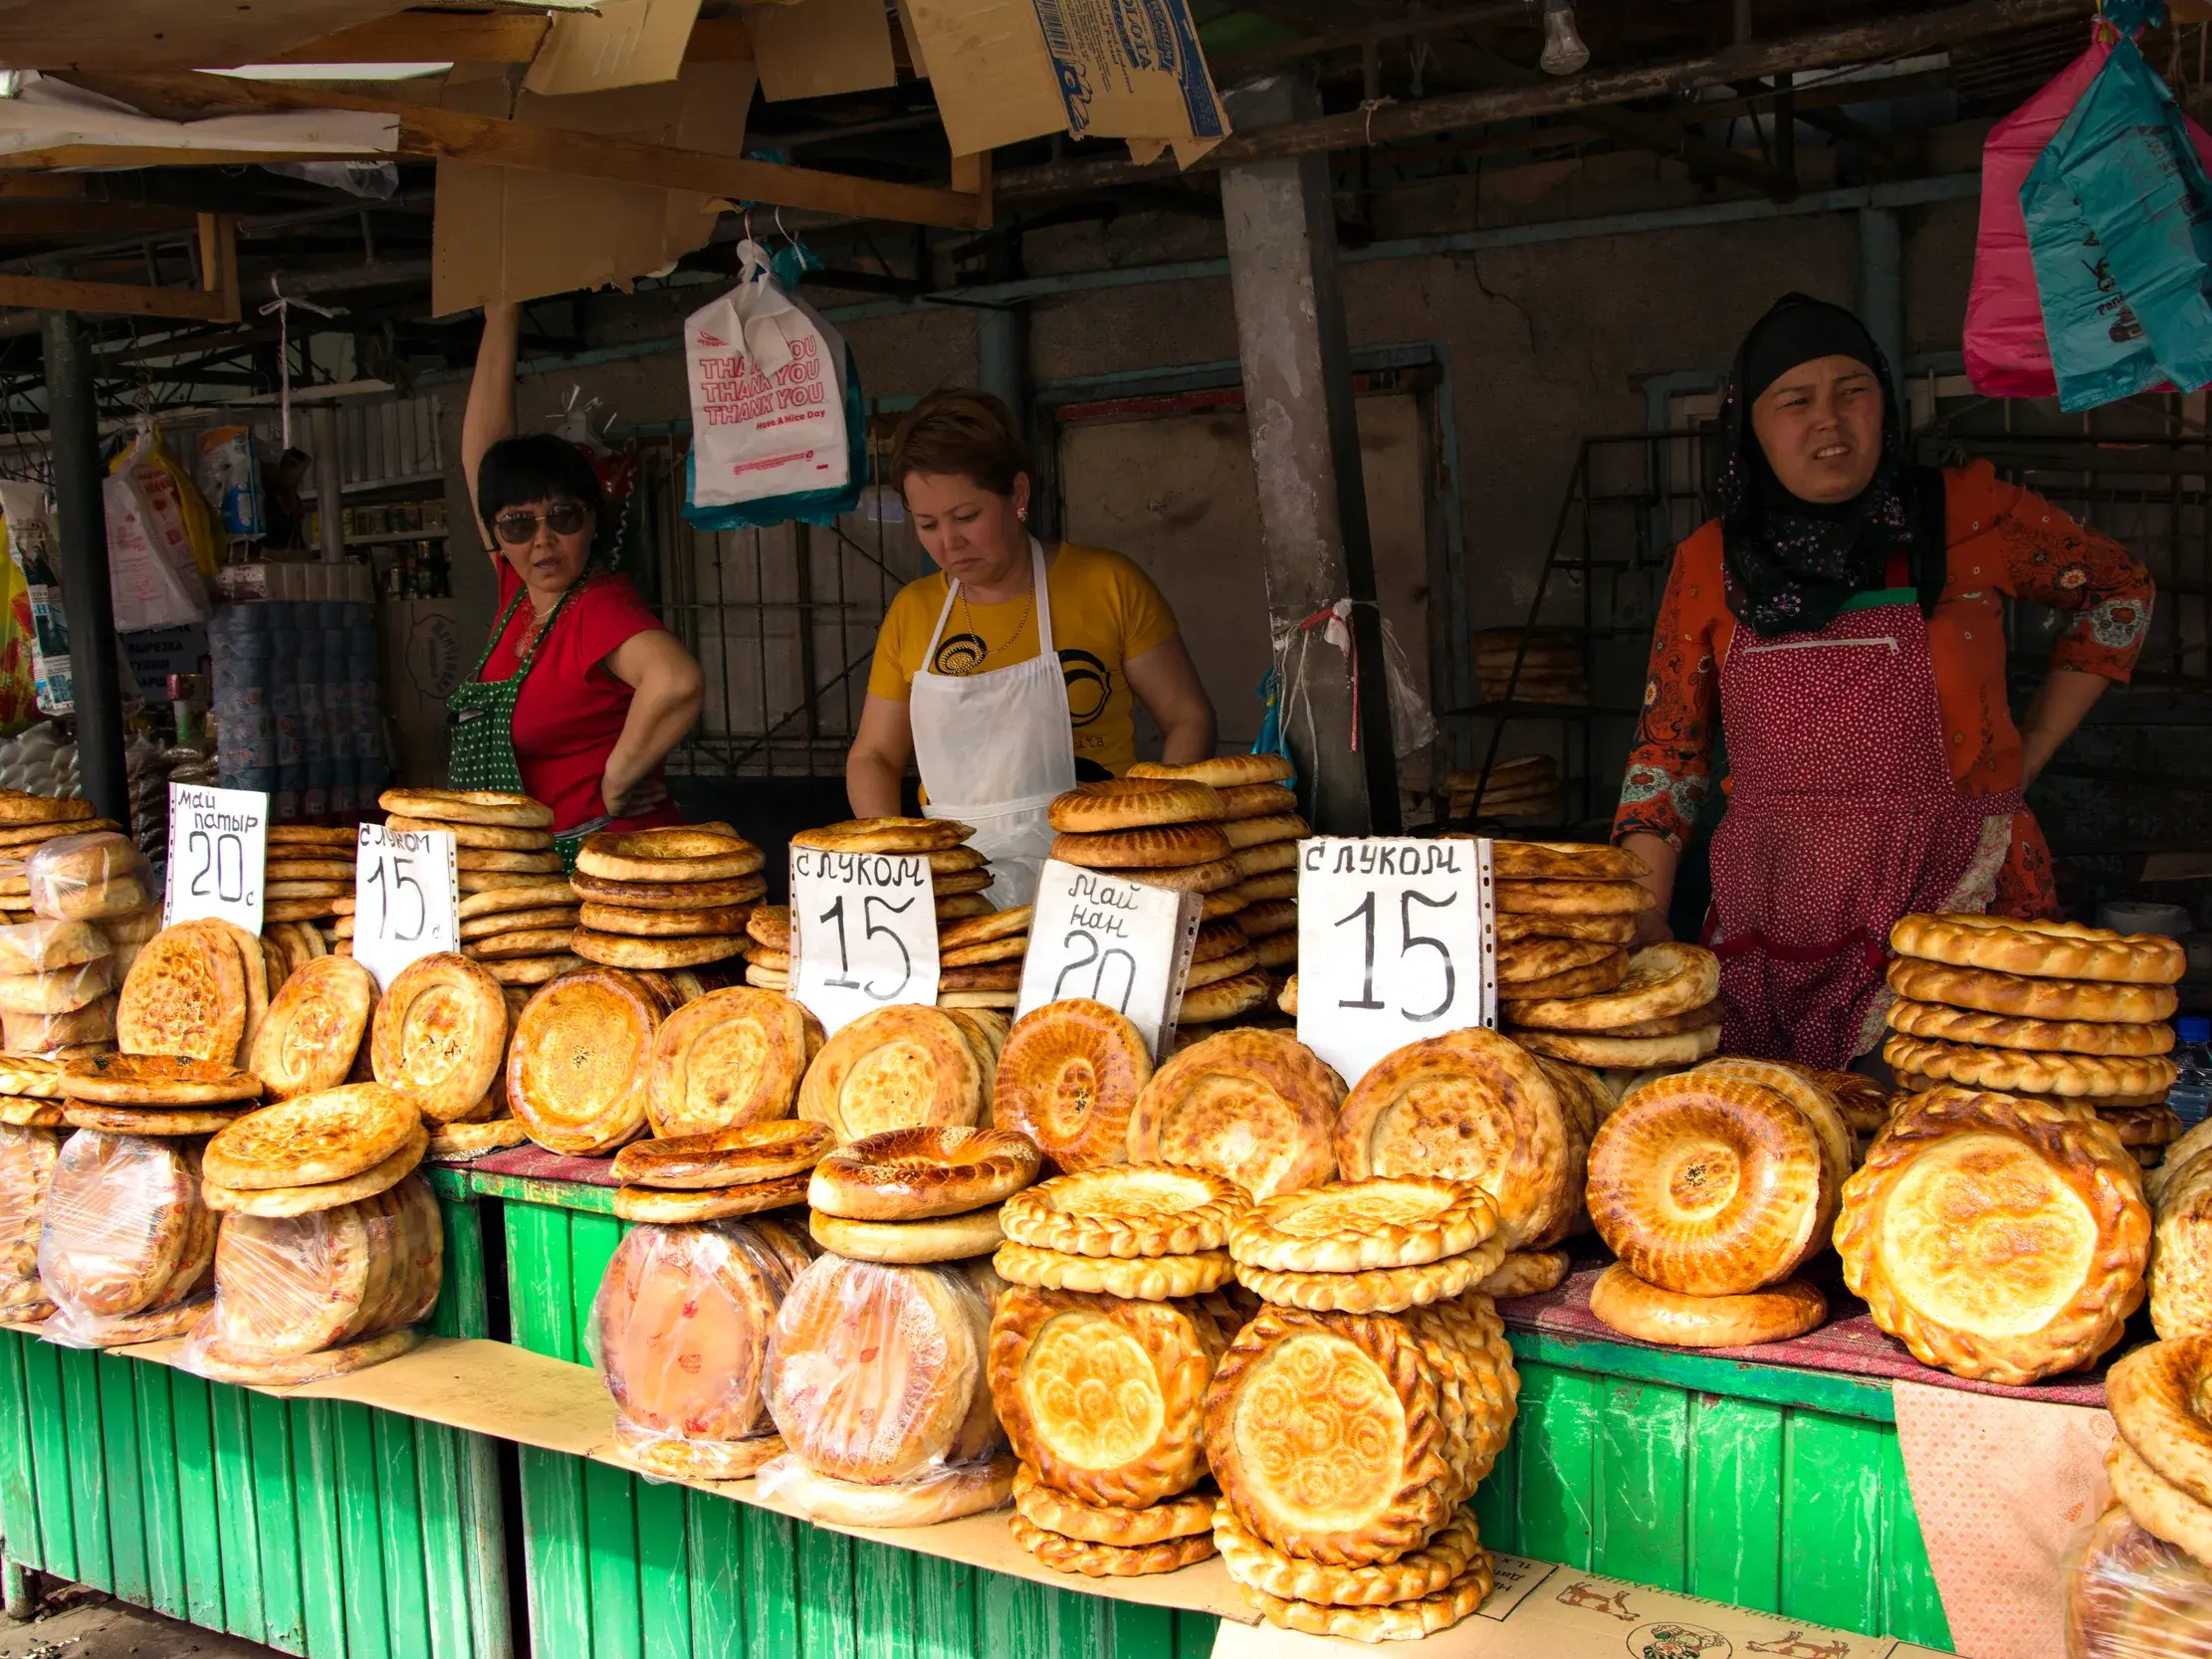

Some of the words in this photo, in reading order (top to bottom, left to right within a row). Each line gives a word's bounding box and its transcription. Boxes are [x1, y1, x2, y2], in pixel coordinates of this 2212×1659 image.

[786, 335, 816, 360] OU
[702, 374, 773, 403] THANK
[775, 358, 820, 386] YOU
[704, 392, 774, 425] THANK
[776, 382, 824, 409] YOU
[757, 420, 775, 431] Have
[777, 417, 784, 426] A
[785, 412, 804, 423] Nice
[807, 408, 826, 420] Day
[1069, 735, 1104, 748] ita
[1068, 874, 1141, 910] Май
[819, 895, 915, 1000] 15
[1334, 890, 1456, 1022] 15
[1051, 930, 1136, 1015] 20
